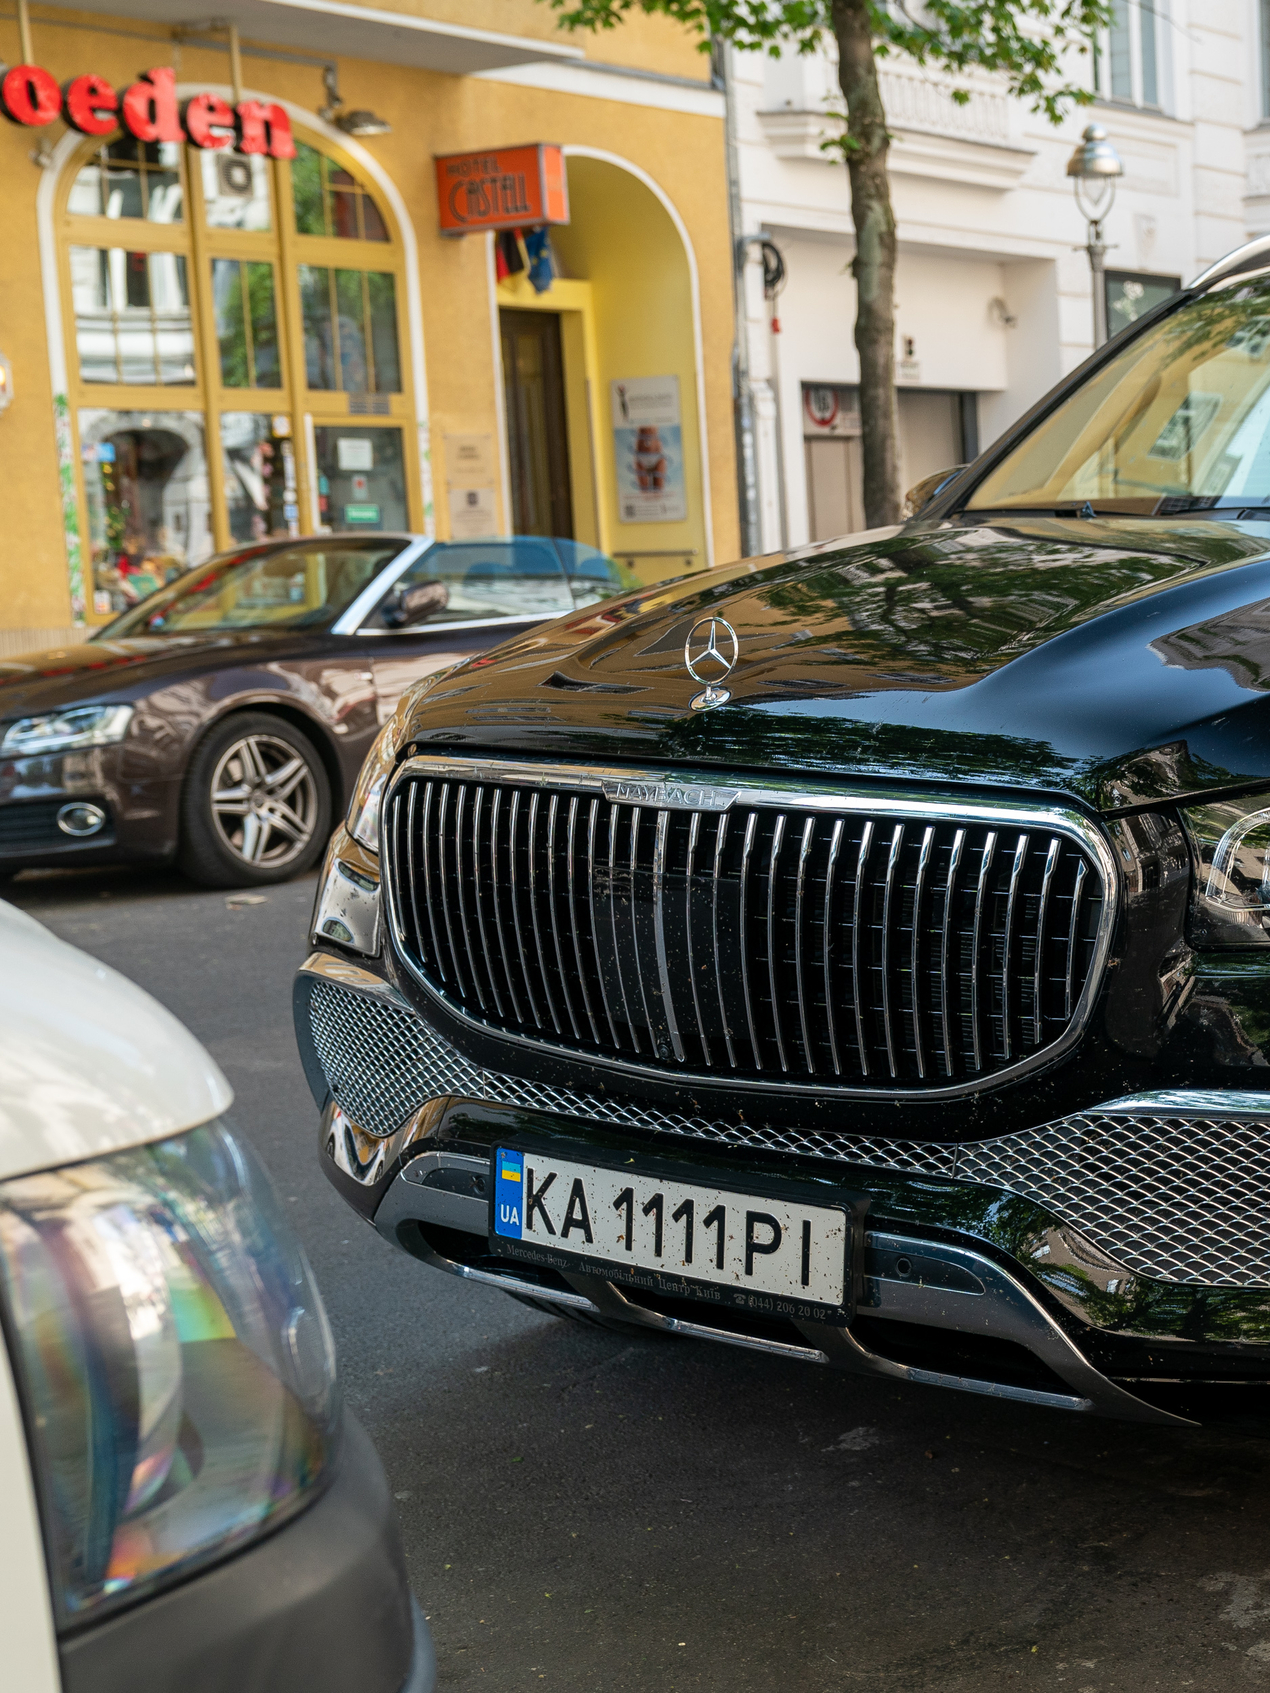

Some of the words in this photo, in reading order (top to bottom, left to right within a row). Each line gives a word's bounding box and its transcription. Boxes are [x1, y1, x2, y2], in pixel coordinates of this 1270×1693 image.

[2, 64, 297, 160] oeden
[446, 156, 501, 177] HOTEL
[449, 171, 532, 223] CASTELL
[616, 783, 716, 806] MAYBACH
[501, 1204, 520, 1226] UA
[526, 1168, 594, 1244] KA
[613, 1186, 727, 1270] 1111
[745, 1210, 812, 1287] PI
[506, 1244, 568, 1269] Mercedes-Benz
[659, 1277, 691, 1296] Центр
[776, 1301, 796, 1315] 206
[798, 1305, 811, 1317] 20
[813, 1308, 826, 1320] 02
